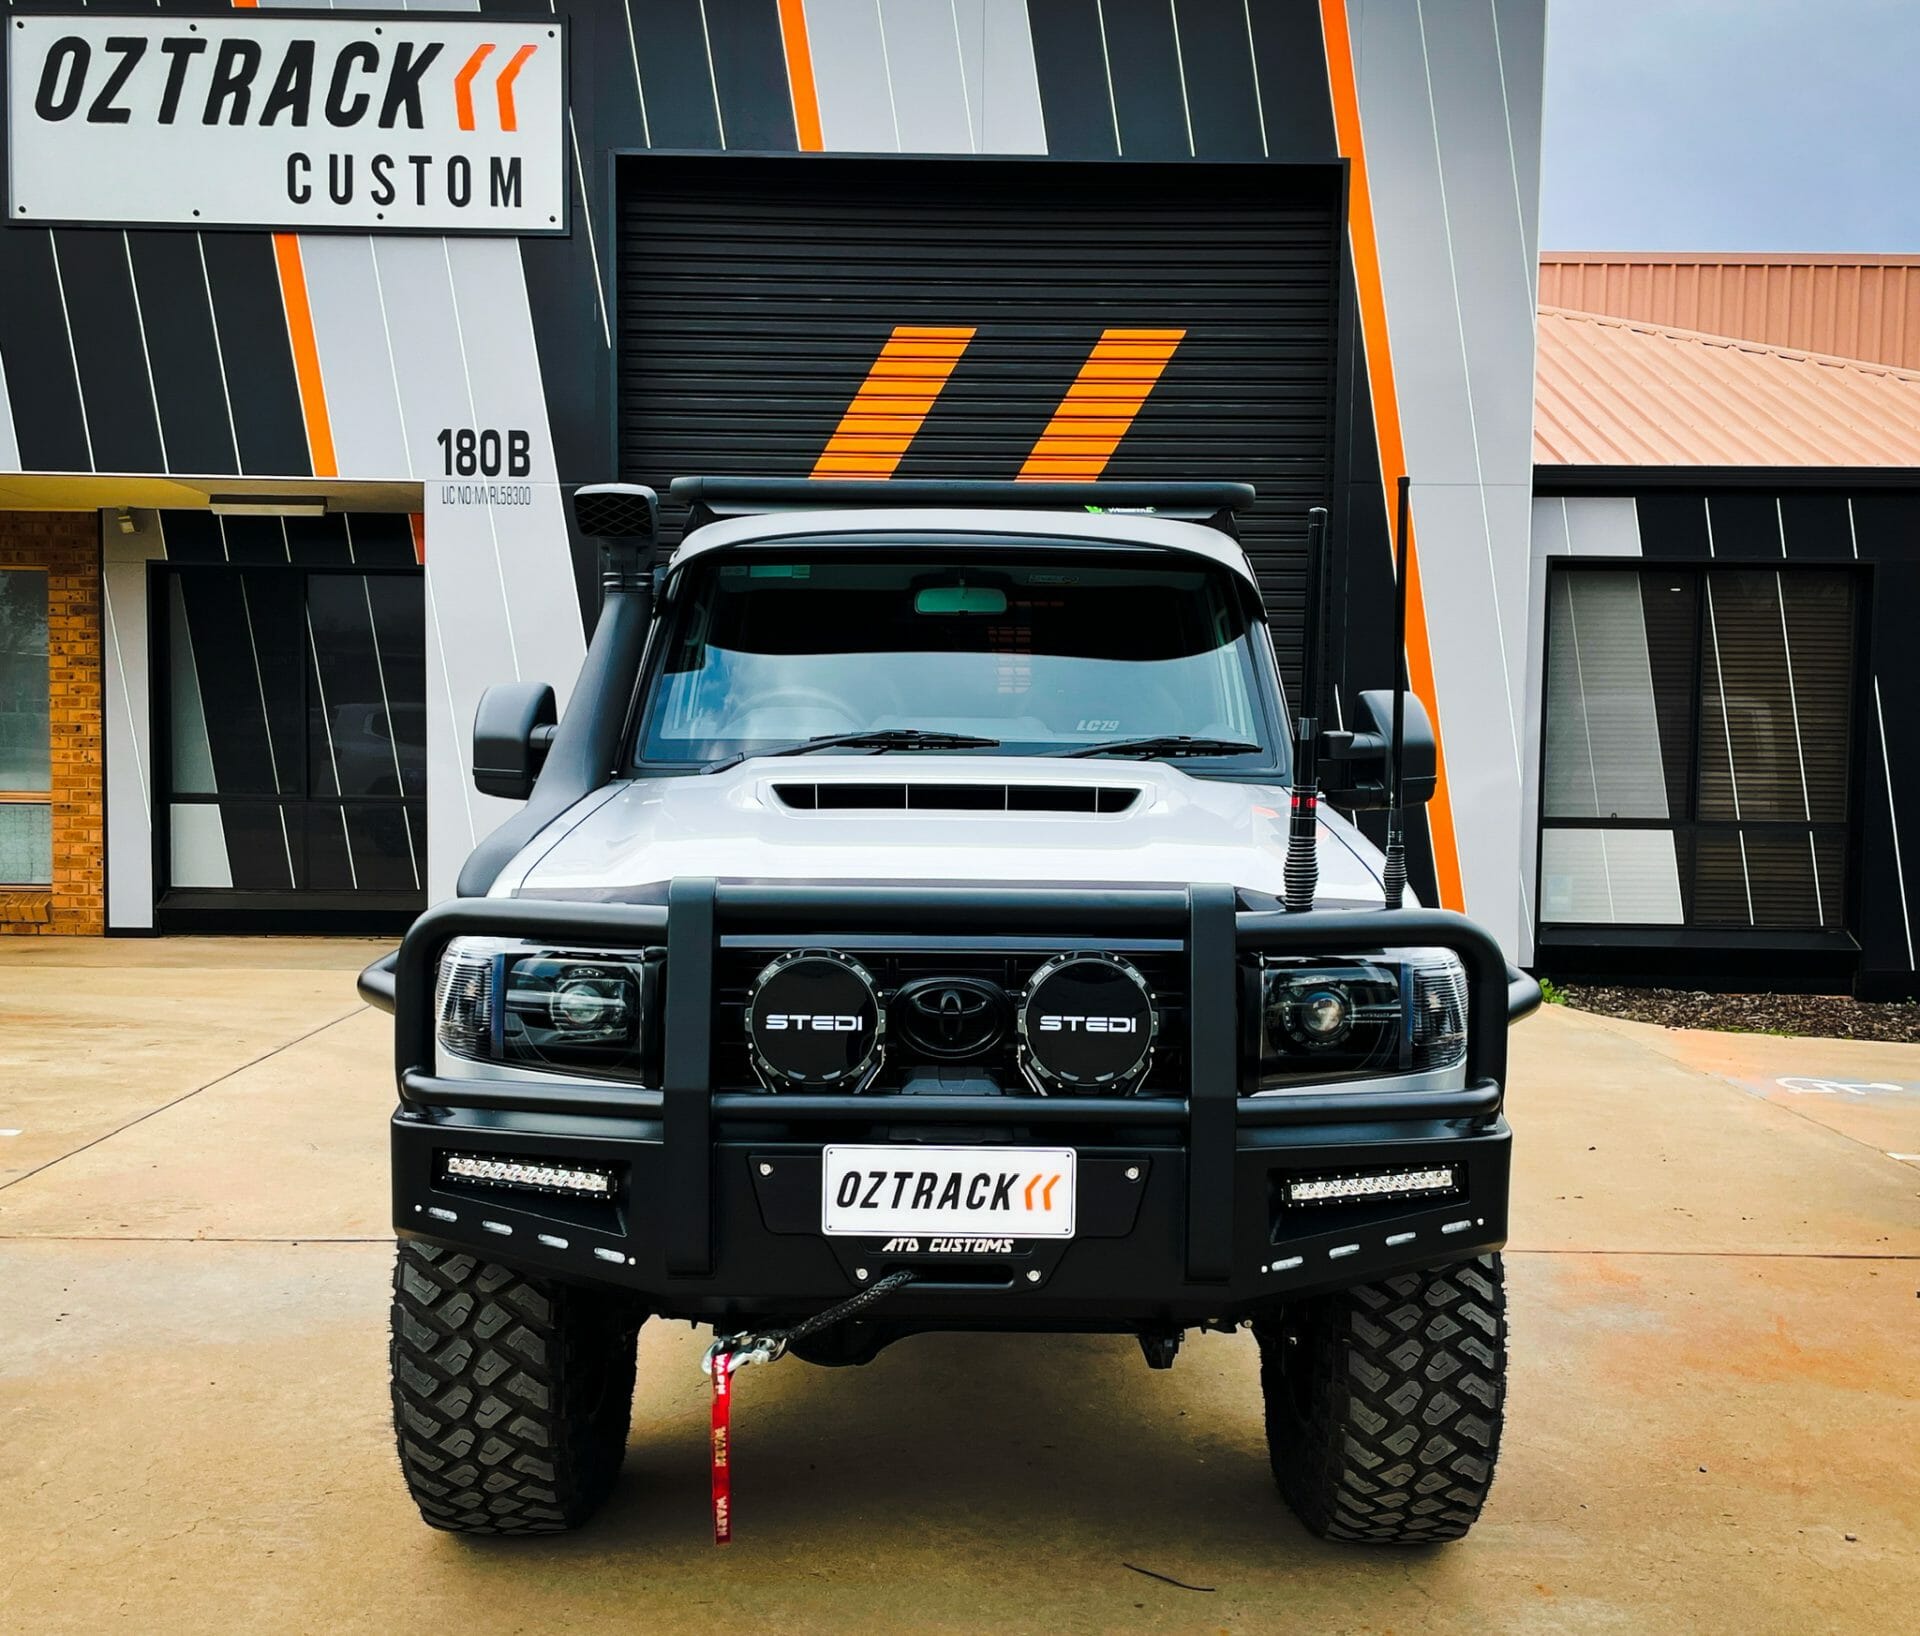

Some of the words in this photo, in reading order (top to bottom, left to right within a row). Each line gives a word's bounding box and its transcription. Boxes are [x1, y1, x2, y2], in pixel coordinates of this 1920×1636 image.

[33, 36, 444, 130] OZTRACK
[287, 151, 523, 208] CUSTOM
[437, 428, 531, 477] 180B
[442, 485, 455, 505] LIC
[765, 1014, 863, 1031] STEDI
[1039, 1015, 1137, 1034] STEDI
[836, 1170, 1020, 1211] OZTRACK
[928, 1238, 1014, 1254] CUSTOMS
[715, 1426, 727, 1468] WARN
[716, 1496, 728, 1537] WARN
